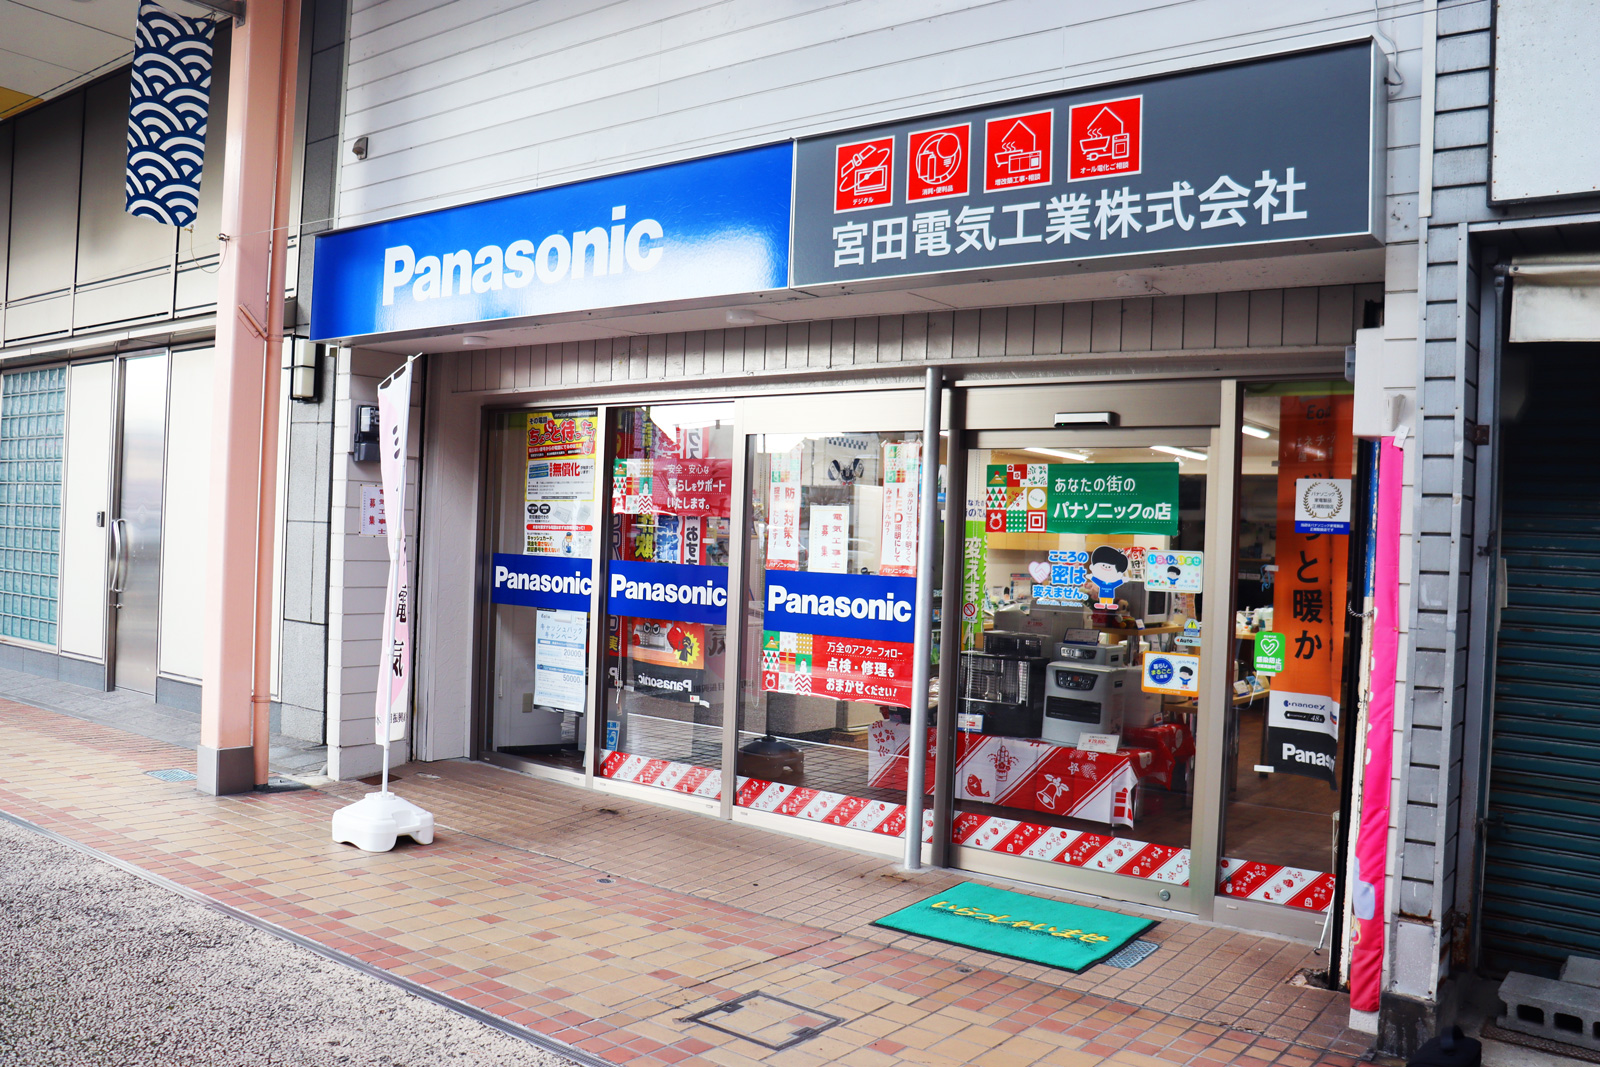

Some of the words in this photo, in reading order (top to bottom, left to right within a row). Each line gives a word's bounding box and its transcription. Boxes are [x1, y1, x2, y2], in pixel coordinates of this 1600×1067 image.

[1080, 162, 1129, 175] オール電化ご相談
[852, 197, 874, 206] デジタル
[832, 166, 1308, 268] 宮田電気工業株式会社
[382, 205, 664, 306] Panasonic
[552, 462, 581, 477] 無償化
[666, 463, 710, 475] 安全・安心な
[666, 479, 727, 494] 暮らしをサポート
[1054, 475, 1136, 493] あなたの街の
[666, 496, 711, 511] いたします。
[1053, 501, 1172, 520] パナソニックの店
[893, 487, 904, 562] LED照明にして
[831, 513, 843, 569] 電気工事士
[1048, 550, 1089, 563] こころの
[1147, 553, 1202, 567] いらっしゃいませ
[495, 565, 592, 596] Panasonic
[1051, 564, 1087, 585] 密は
[610, 573, 727, 607] Panasonic
[1032, 585, 1089, 601] 変えません。
[767, 584, 912, 623] Panasonic
[826, 641, 904, 659] 万全のアフターフォロー
[826, 656, 896, 679] 点検・修理も
[1150, 668, 1172, 676] まるごと
[825, 678, 898, 698] おまかせください!
[931, 900, 1111, 944] いらっしゃいませ
